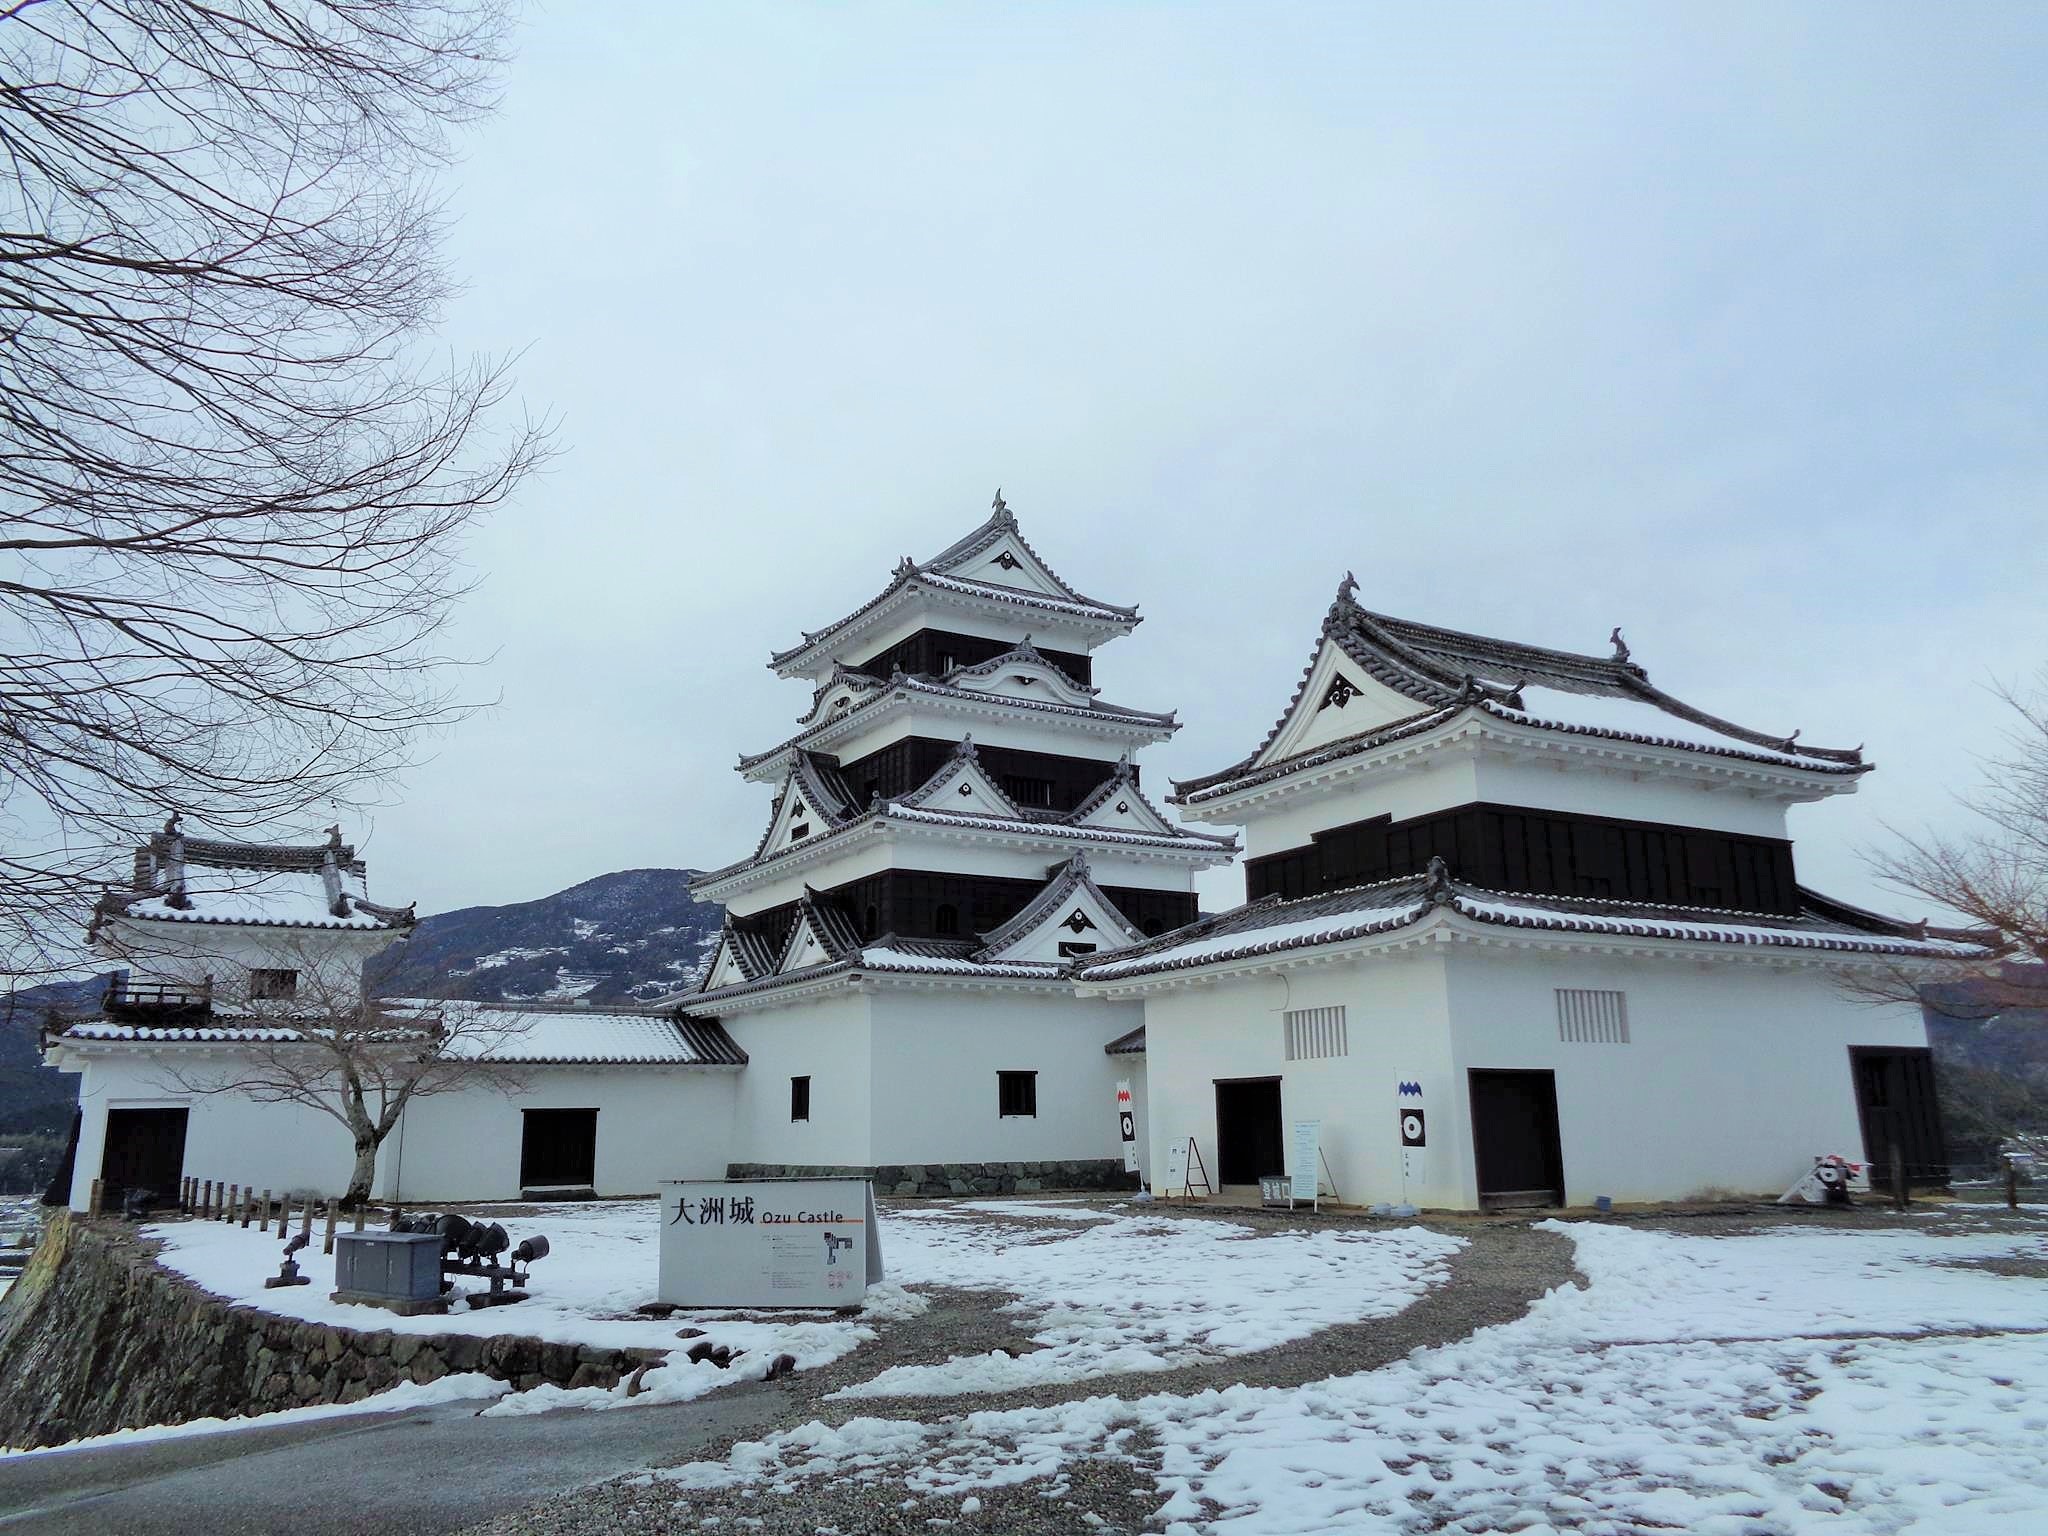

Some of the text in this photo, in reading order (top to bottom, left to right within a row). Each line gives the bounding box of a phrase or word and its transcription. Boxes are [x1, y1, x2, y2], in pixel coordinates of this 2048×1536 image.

[670, 1196, 755, 1225] 大洲城
[762, 1210, 844, 1224] Ozu Castle
